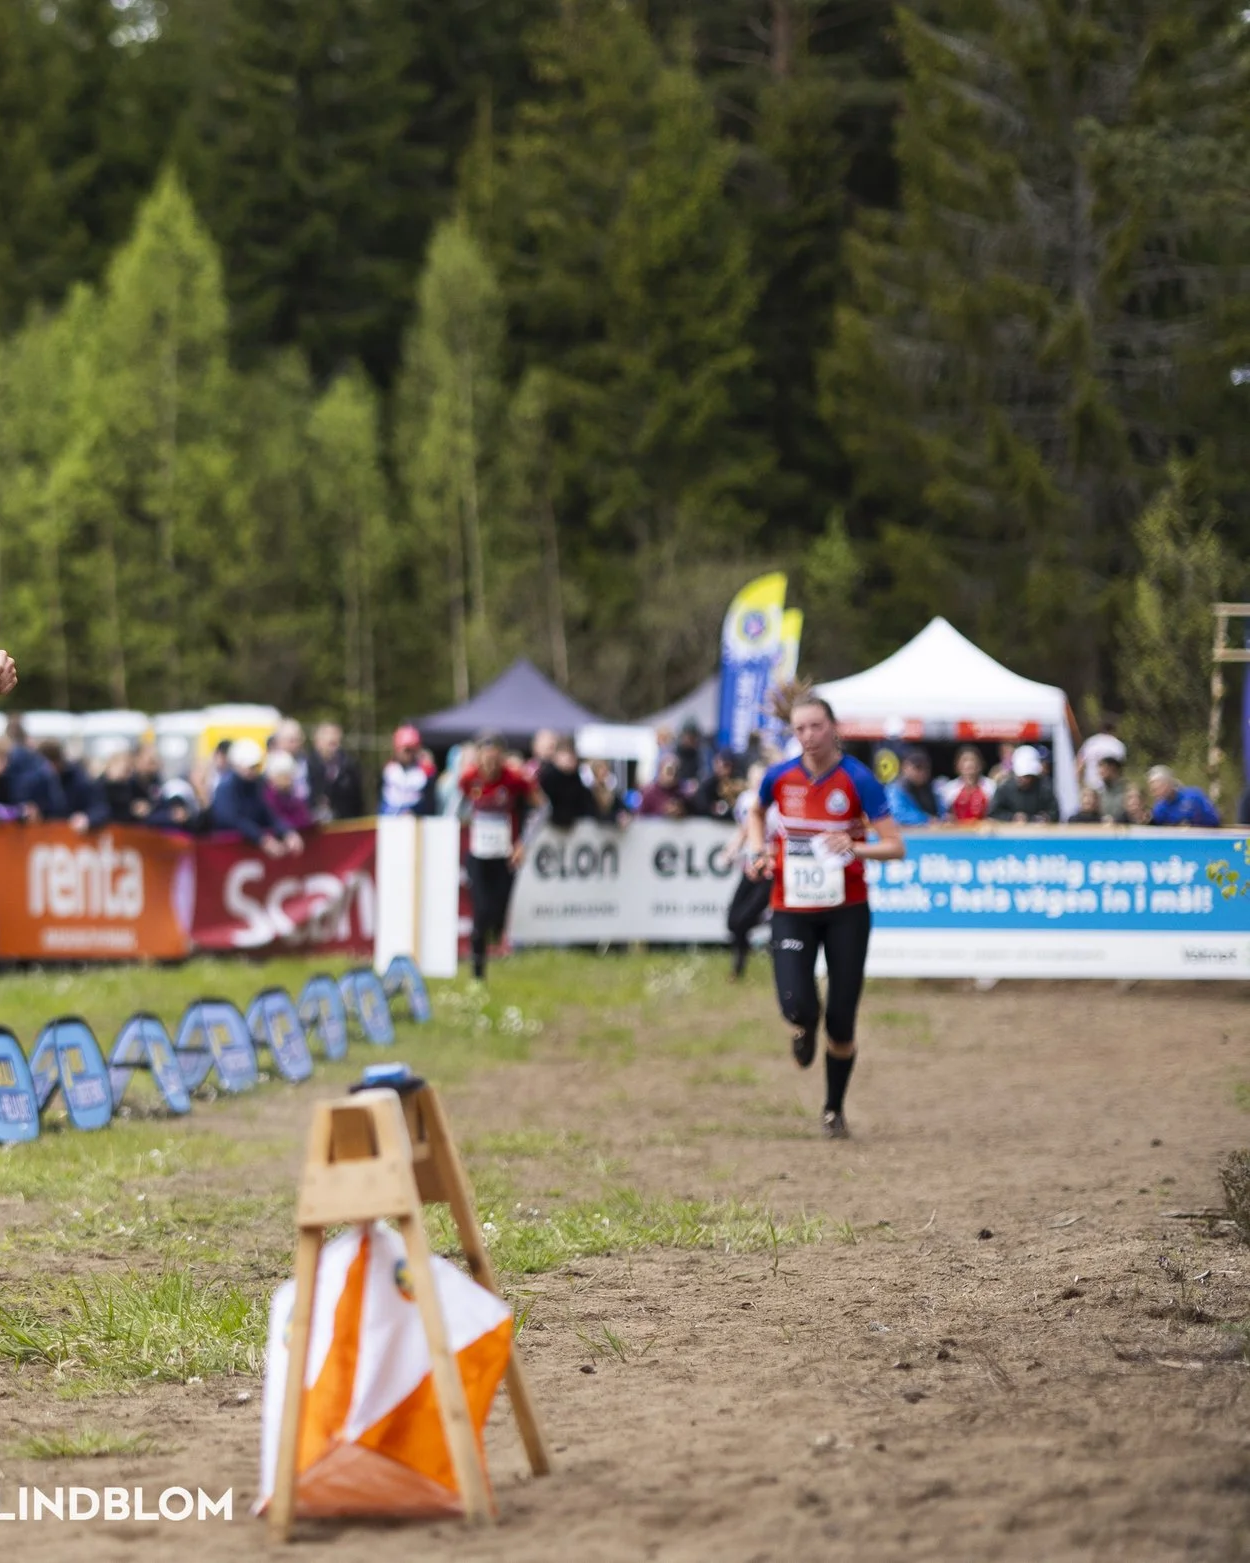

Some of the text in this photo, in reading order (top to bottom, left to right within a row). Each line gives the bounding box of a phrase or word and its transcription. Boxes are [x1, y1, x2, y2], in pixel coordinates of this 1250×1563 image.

[27, 834, 145, 919] renta
[1088, 860, 1147, 884] som
[1151, 854, 1198, 884] vår
[224, 859, 377, 948] Scan
[951, 884, 1011, 913] hela
[1014, 885, 1098, 918] vägen
[1102, 885, 1130, 913] in
